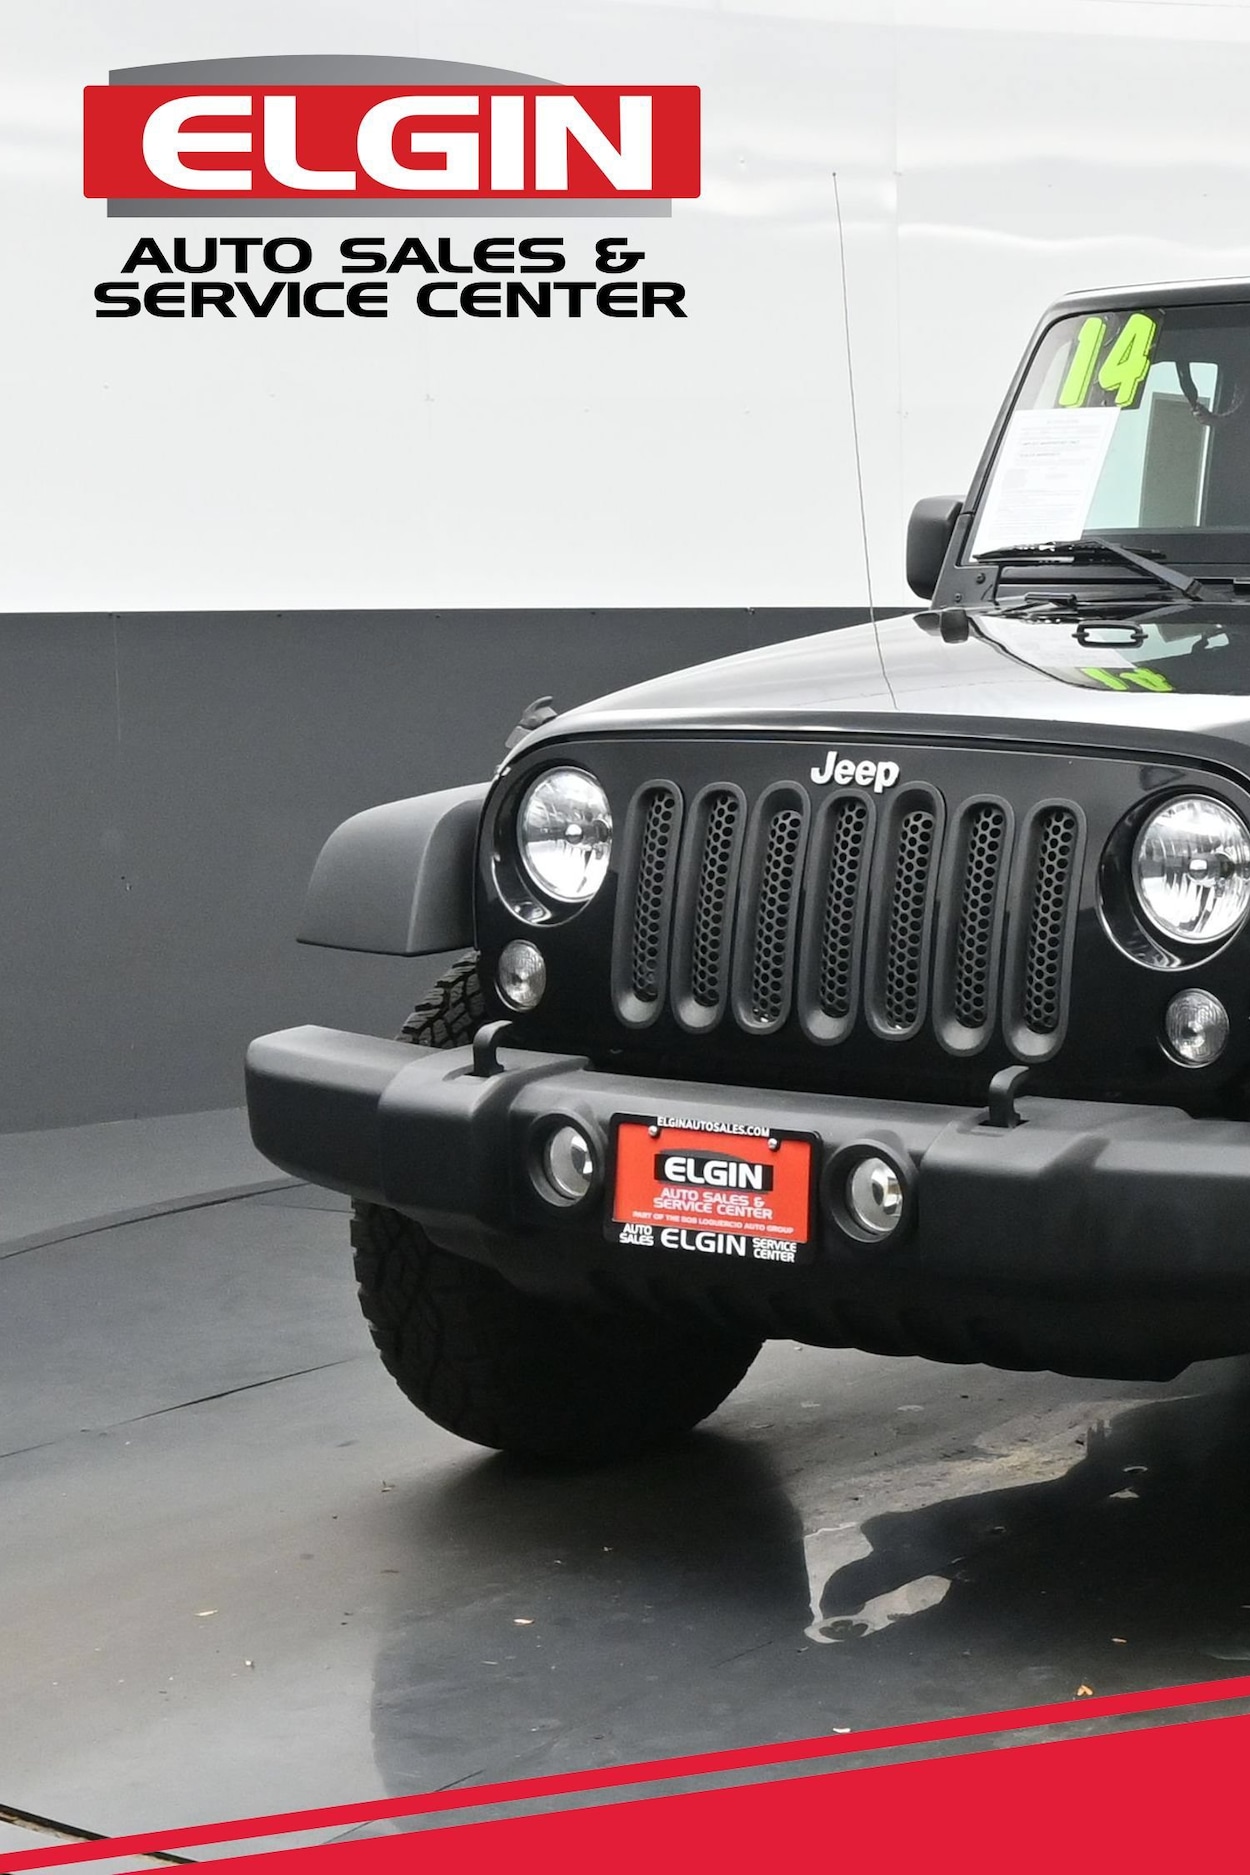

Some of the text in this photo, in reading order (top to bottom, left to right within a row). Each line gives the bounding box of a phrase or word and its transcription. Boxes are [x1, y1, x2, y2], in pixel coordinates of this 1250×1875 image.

[1059, 312, 1157, 408] 14
[810, 751, 900, 793] Jeep
[657, 1116, 770, 1137] ELGINAUTOSALES.COM
[664, 1156, 763, 1190] ELGIN
[653, 1197, 773, 1219] SERVICE CENTER
[661, 1187, 765, 1208] AUTO SALES &
[623, 1222, 653, 1235] AUTO
[744, 1222, 765, 1231] AUTO
[619, 1232, 654, 1246] SALES
[660, 1228, 746, 1257] ELGIN
[752, 1237, 797, 1253] SERVICE
[753, 1248, 795, 1263] CENTER
